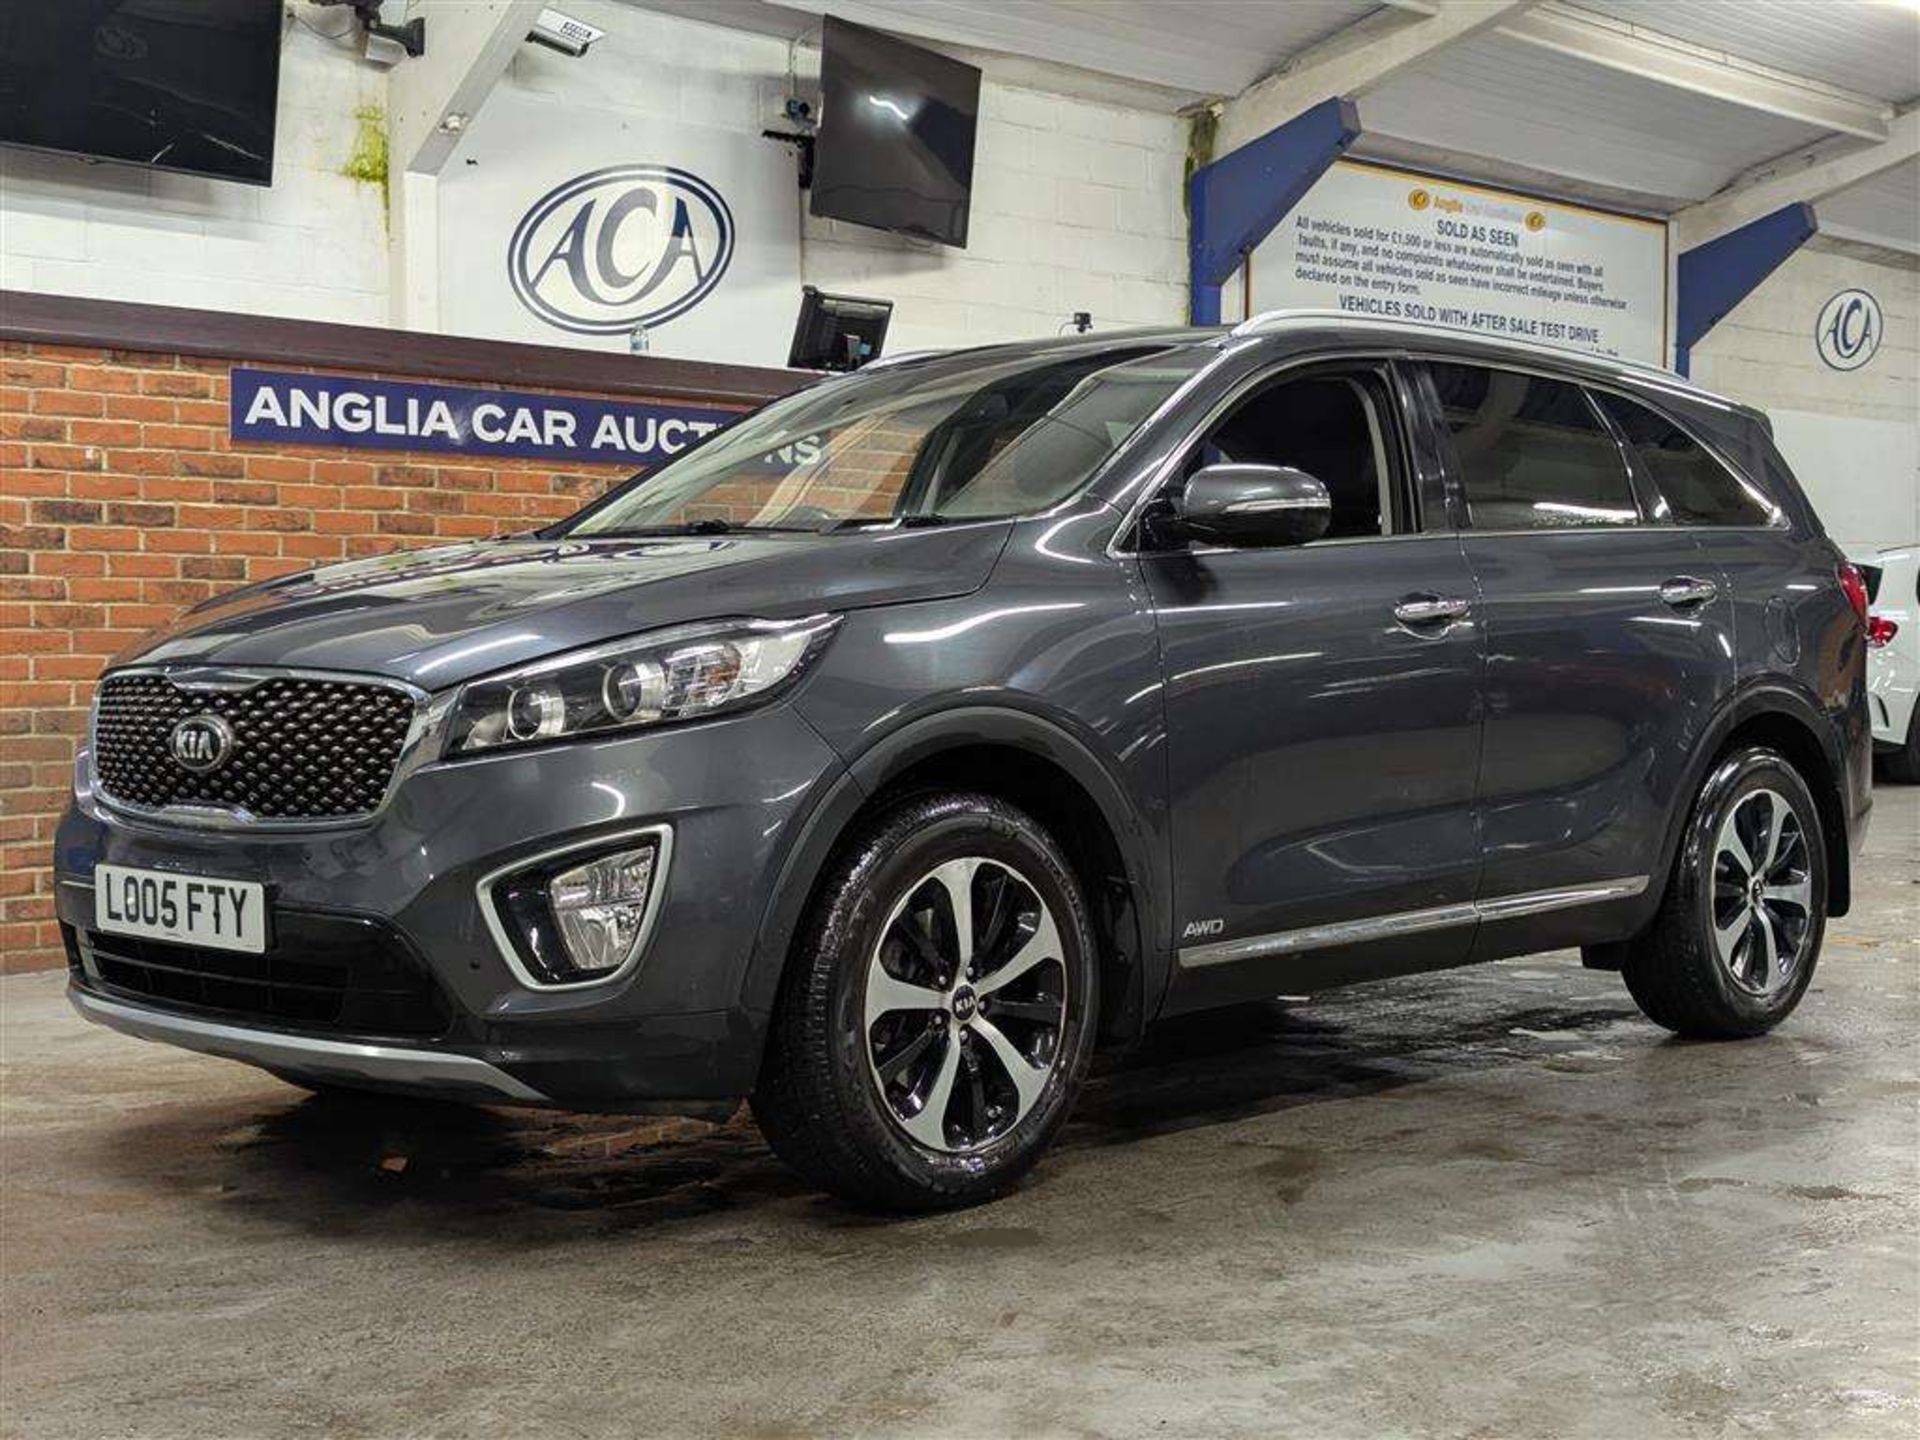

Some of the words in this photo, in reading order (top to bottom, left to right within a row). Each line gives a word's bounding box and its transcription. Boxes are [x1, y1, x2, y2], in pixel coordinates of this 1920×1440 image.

[529, 187, 705, 306] ACA
[1296, 215, 1309, 229] All
[1311, 220, 1350, 236] vehicles
[1354, 227, 1373, 240] sold
[1470, 247, 1523, 266] automatically
[1525, 256, 1543, 268] sold
[1437, 219, 1468, 239] SOLD
[1471, 226, 1486, 242] AS
[1488, 228, 1518, 247] SEEN
[1296, 252, 1319, 265] must
[1322, 256, 1358, 270] assume
[1376, 263, 1412, 278] vehicles
[1415, 269, 1434, 281] sold
[1449, 274, 1468, 286] seen
[1493, 281, 1528, 296] incorrect
[1362, 245, 1379, 257] and
[1382, 248, 1393, 259] no
[1395, 250, 1443, 267] complaints
[1296, 267, 1337, 284] declared
[1340, 275, 1352, 286] on
[1354, 275, 1369, 288] the
[1371, 279, 1394, 294] entry
[1339, 294, 1401, 316] VEHICLES
[1404, 302, 1436, 321] SOLD
[1438, 308, 1468, 325] WITH
[1470, 312, 1506, 331] AFTER
[1508, 317, 1537, 335] SALE
[1539, 322, 1565, 339] TEST
[1568, 325, 1599, 344] DRIVE
[244, 386, 458, 438] ANGLIA
[472, 403, 577, 447] CAR
[175, 730, 214, 760] KIA
[187, 882, 248, 938] FTY
[1182, 918, 1223, 938] AWD
